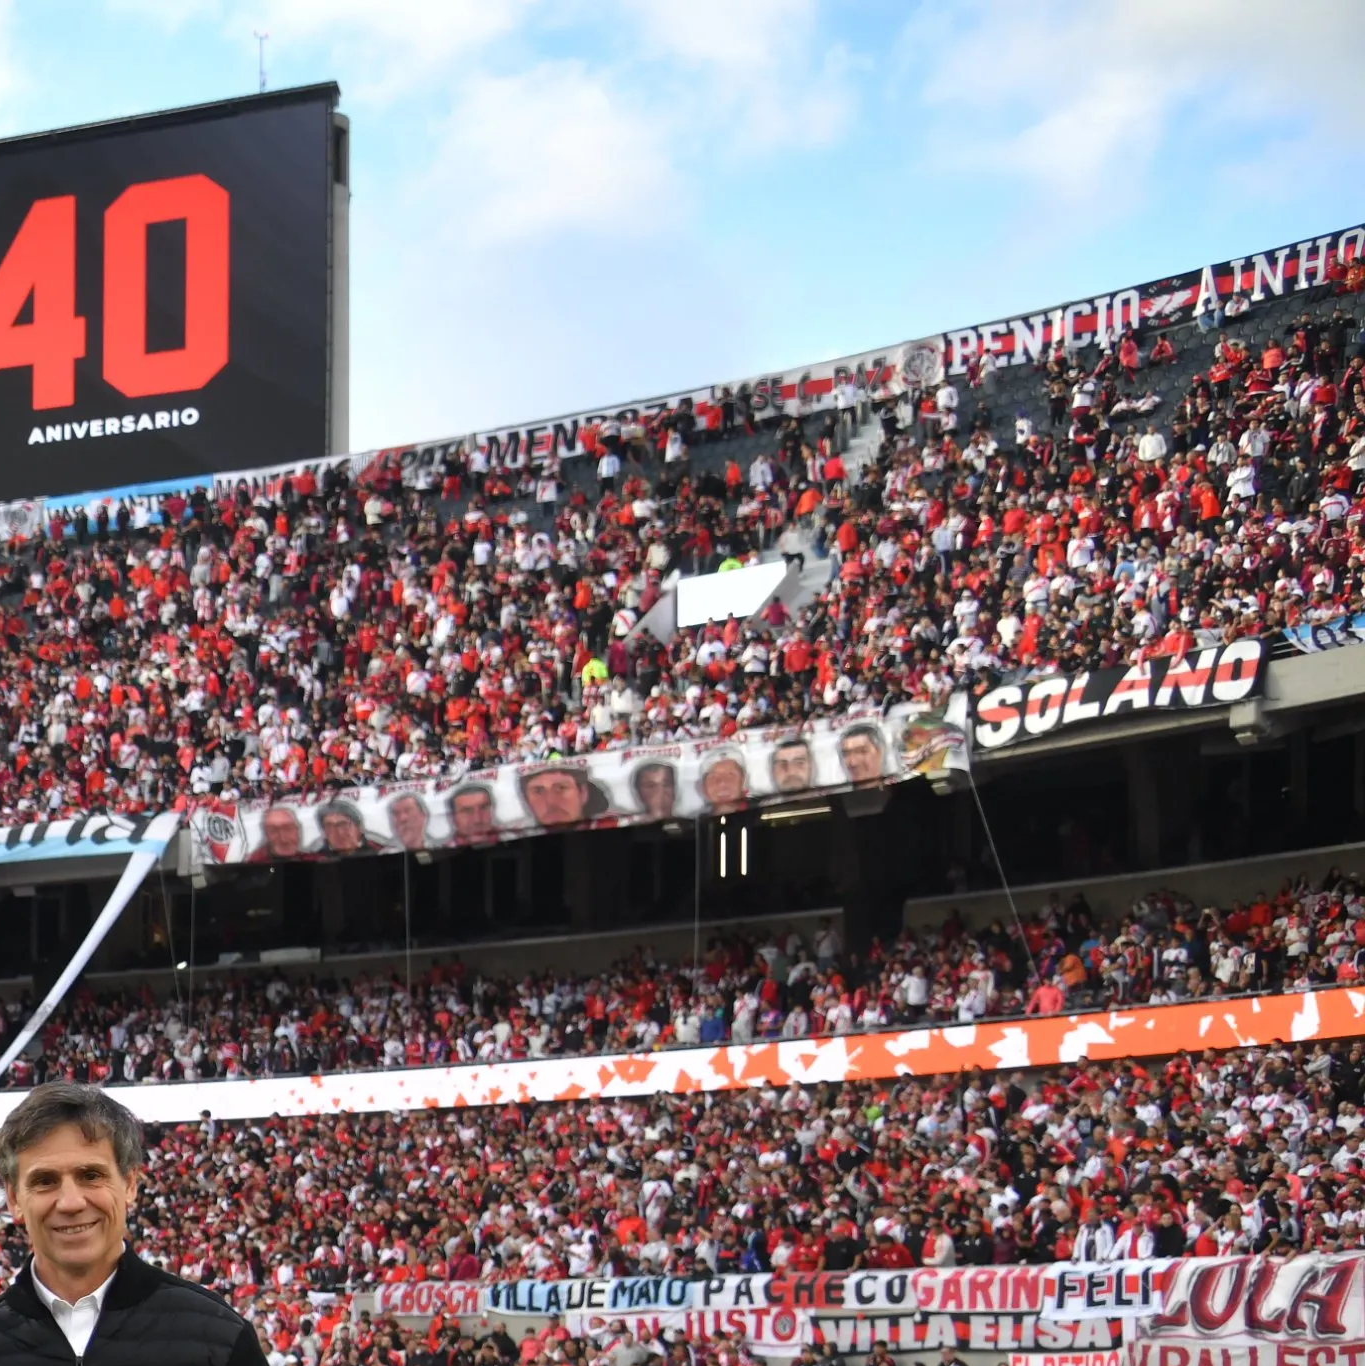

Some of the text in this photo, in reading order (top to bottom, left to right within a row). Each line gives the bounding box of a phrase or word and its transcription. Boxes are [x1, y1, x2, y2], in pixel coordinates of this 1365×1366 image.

[27, 406, 200, 446] ANIVERSARIO
[976, 640, 1262, 748] SOLANO
[490, 1277, 689, 1313] VILLA DE MAYO
[703, 1274, 908, 1307] PACHECO
[912, 1267, 1046, 1310] GARIN
[1056, 1265, 1152, 1310] FELI
[1151, 1257, 1360, 1337] LOLA
[819, 1314, 1112, 1353] VILLA ELISA
